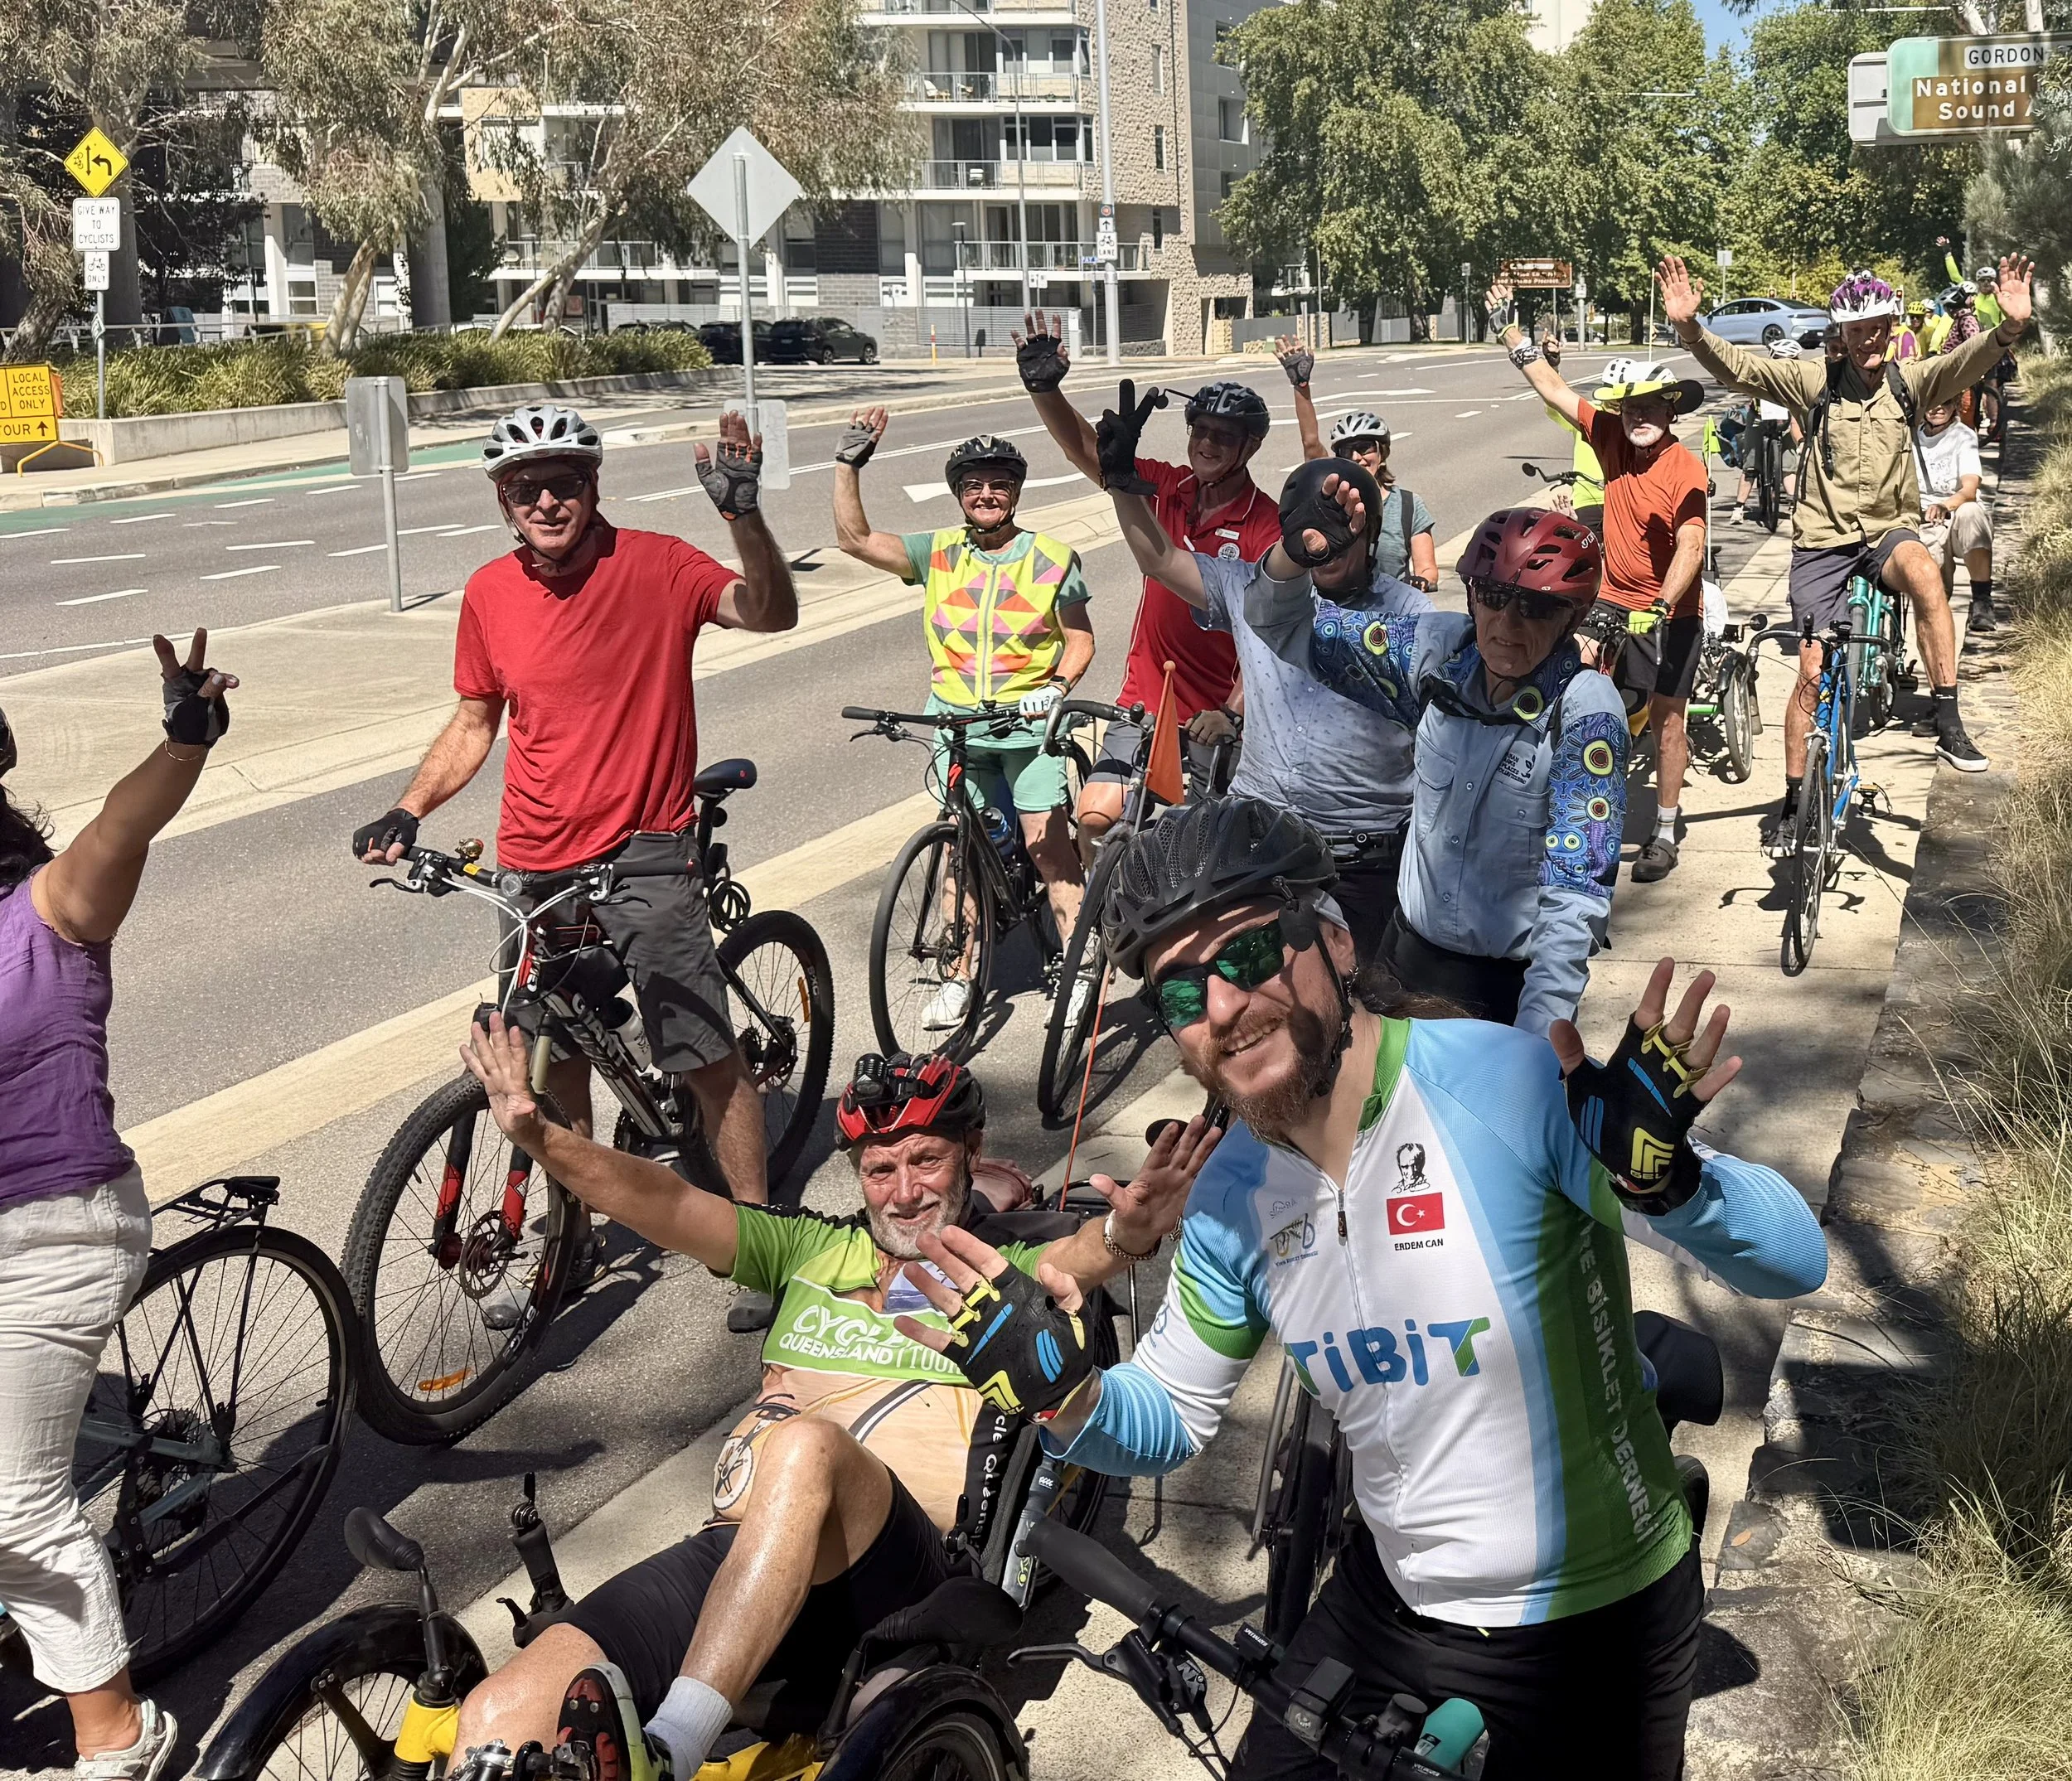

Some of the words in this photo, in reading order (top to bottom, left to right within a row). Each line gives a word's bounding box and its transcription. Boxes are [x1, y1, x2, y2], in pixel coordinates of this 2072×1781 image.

[1968, 47, 2044, 65] GORDON
[1916, 75, 2026, 97] National
[1938, 100, 2015, 120] Sound
[77, 206, 95, 215] GIVE
[99, 206, 115, 215] WAY
[92, 220, 101, 230] TO
[78, 234, 114, 244] CYCLISTS
[87, 274, 105, 283] ONLY
[12, 372, 45, 384] LOCAL
[12, 385, 50, 397] ACCESS
[19, 399, 45, 409] ONLY
[1394, 1242, 1424, 1251] ERDEM
[1426, 1238, 1444, 1247] CAN
[778, 1332, 894, 1366] QUEENSLAND
